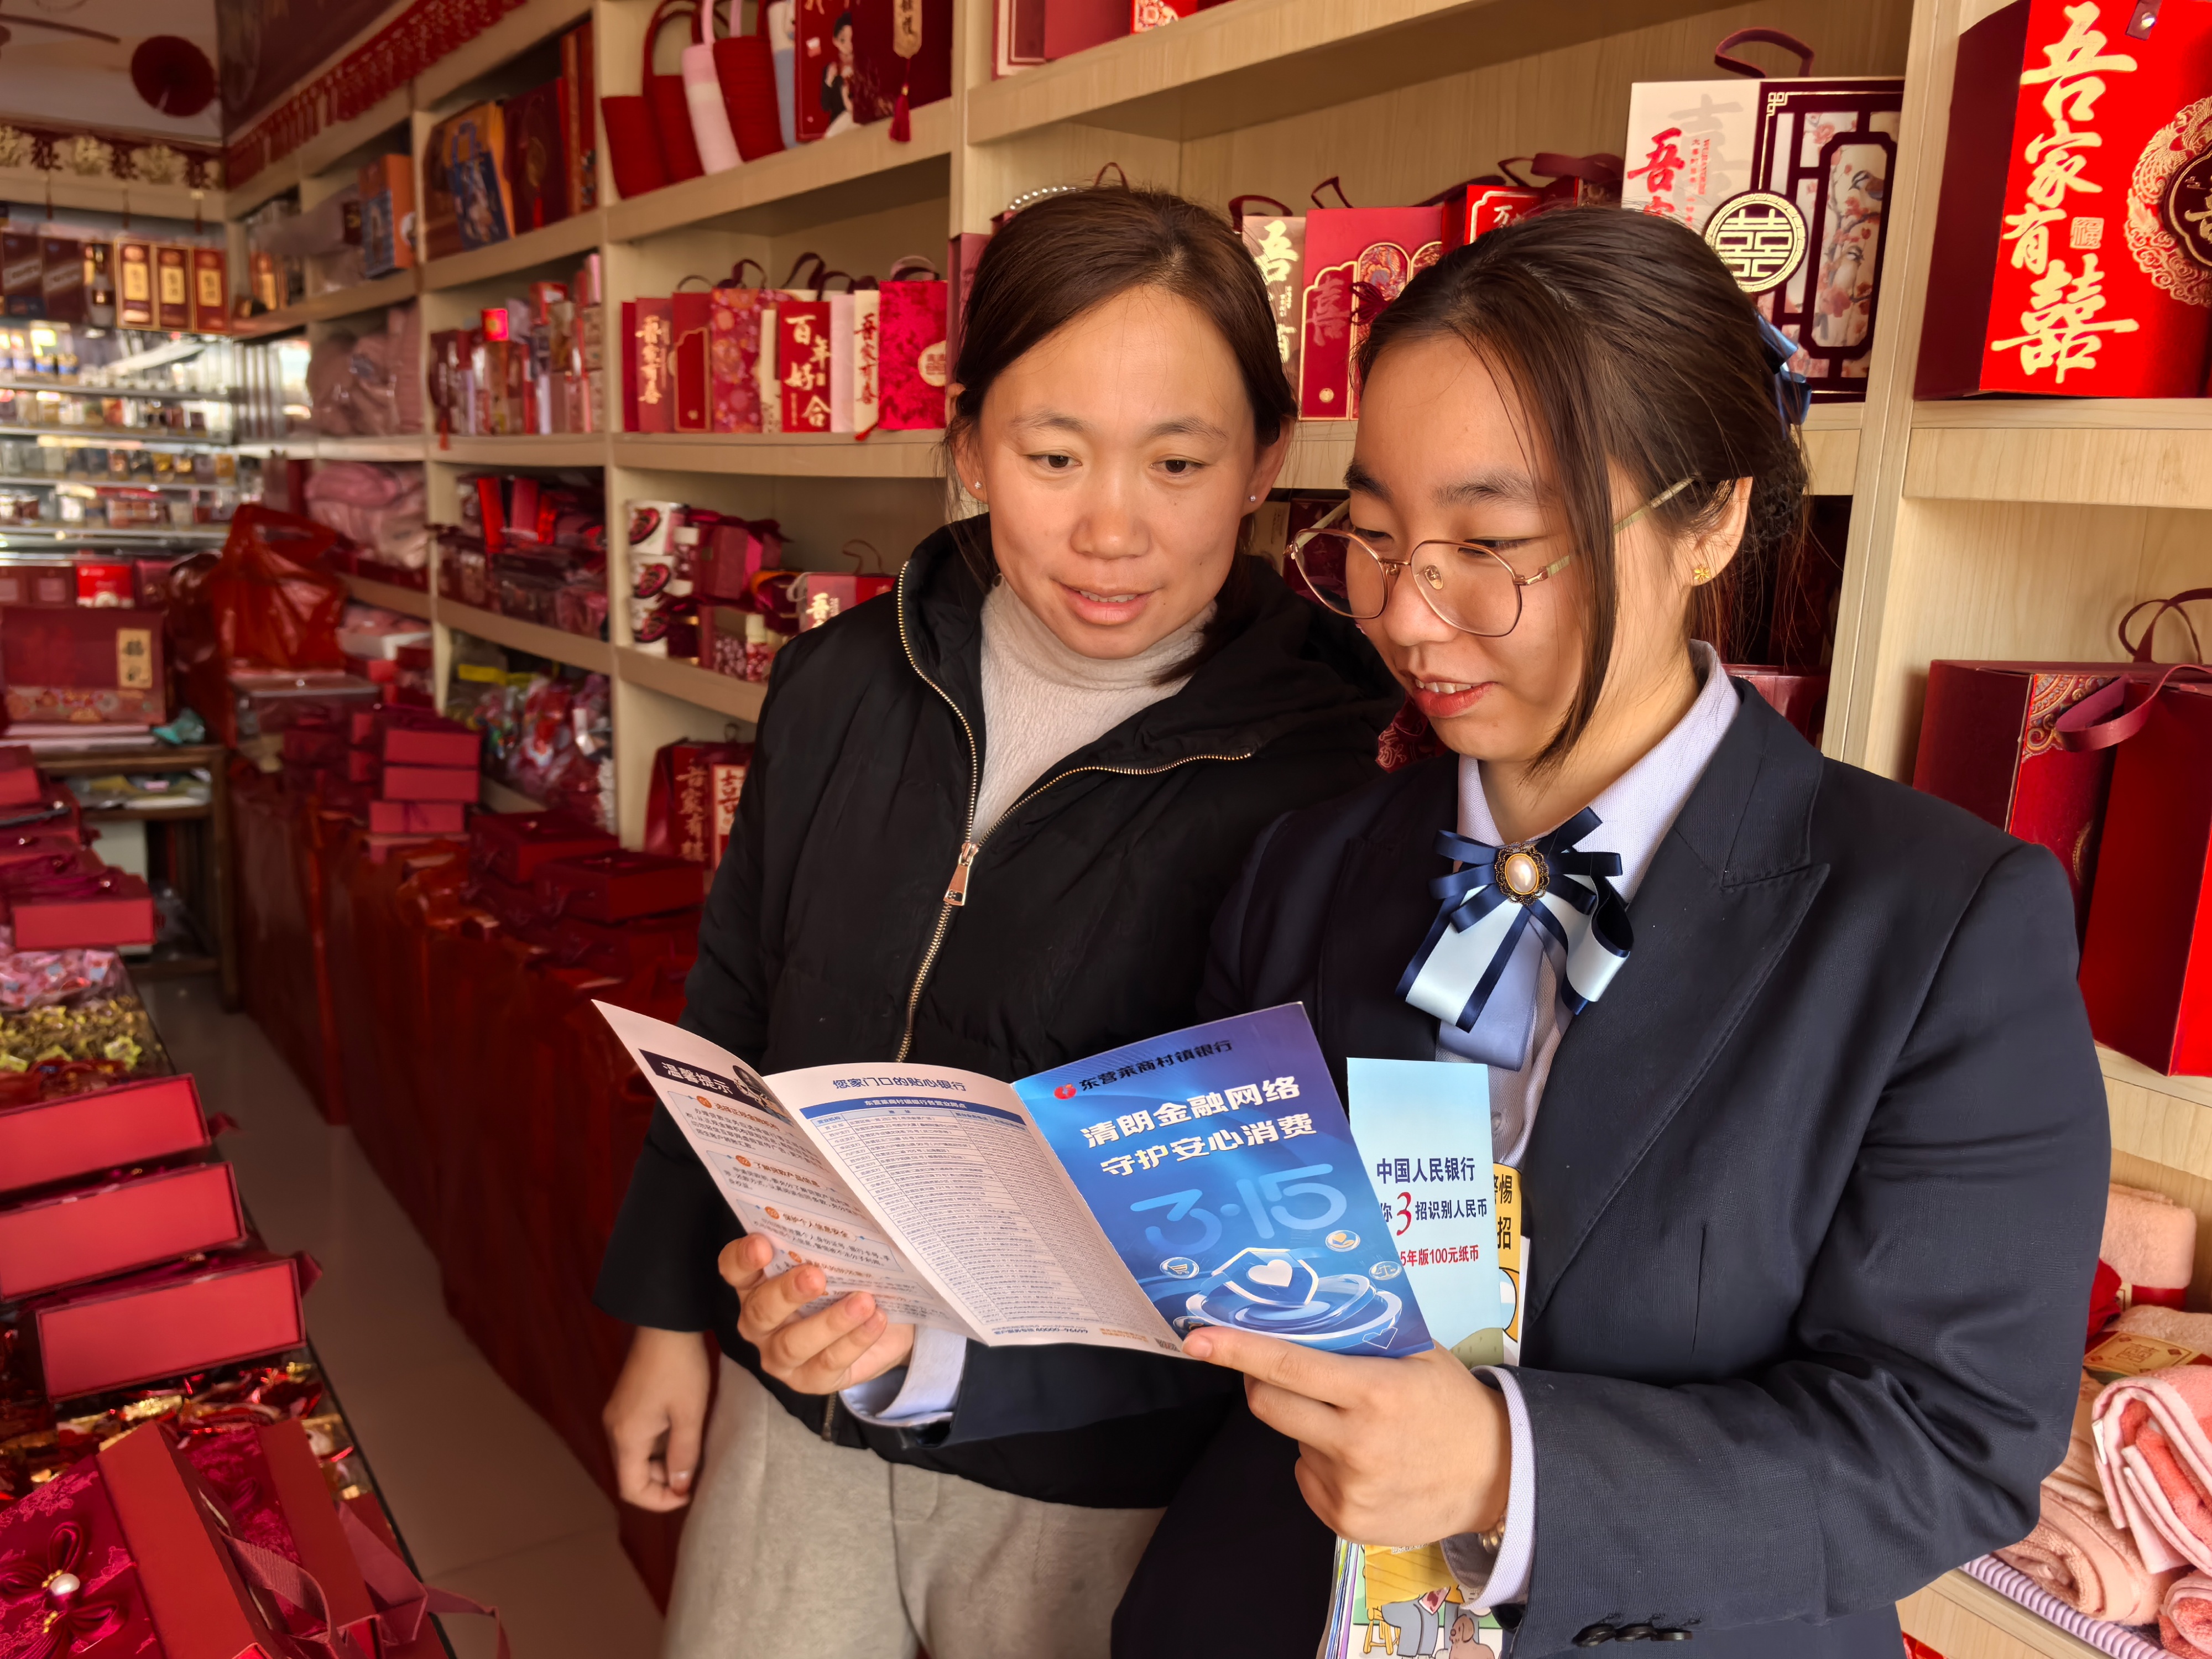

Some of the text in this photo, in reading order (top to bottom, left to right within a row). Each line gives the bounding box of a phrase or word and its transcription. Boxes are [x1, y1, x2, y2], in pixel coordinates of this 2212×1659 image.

[784, 315, 831, 427] 百年好合
[661, 1062, 734, 1095] 温馨提示
[833, 1077, 967, 1092] 您家门口的贴心银行
[1080, 1040, 1233, 1092] 东营莱商村镇银行
[1080, 1076, 1301, 1149] 清朗金融网络
[1100, 1113, 1317, 1177] 守护安心消费
[1376, 1156, 1475, 1185] 中国人民银行
